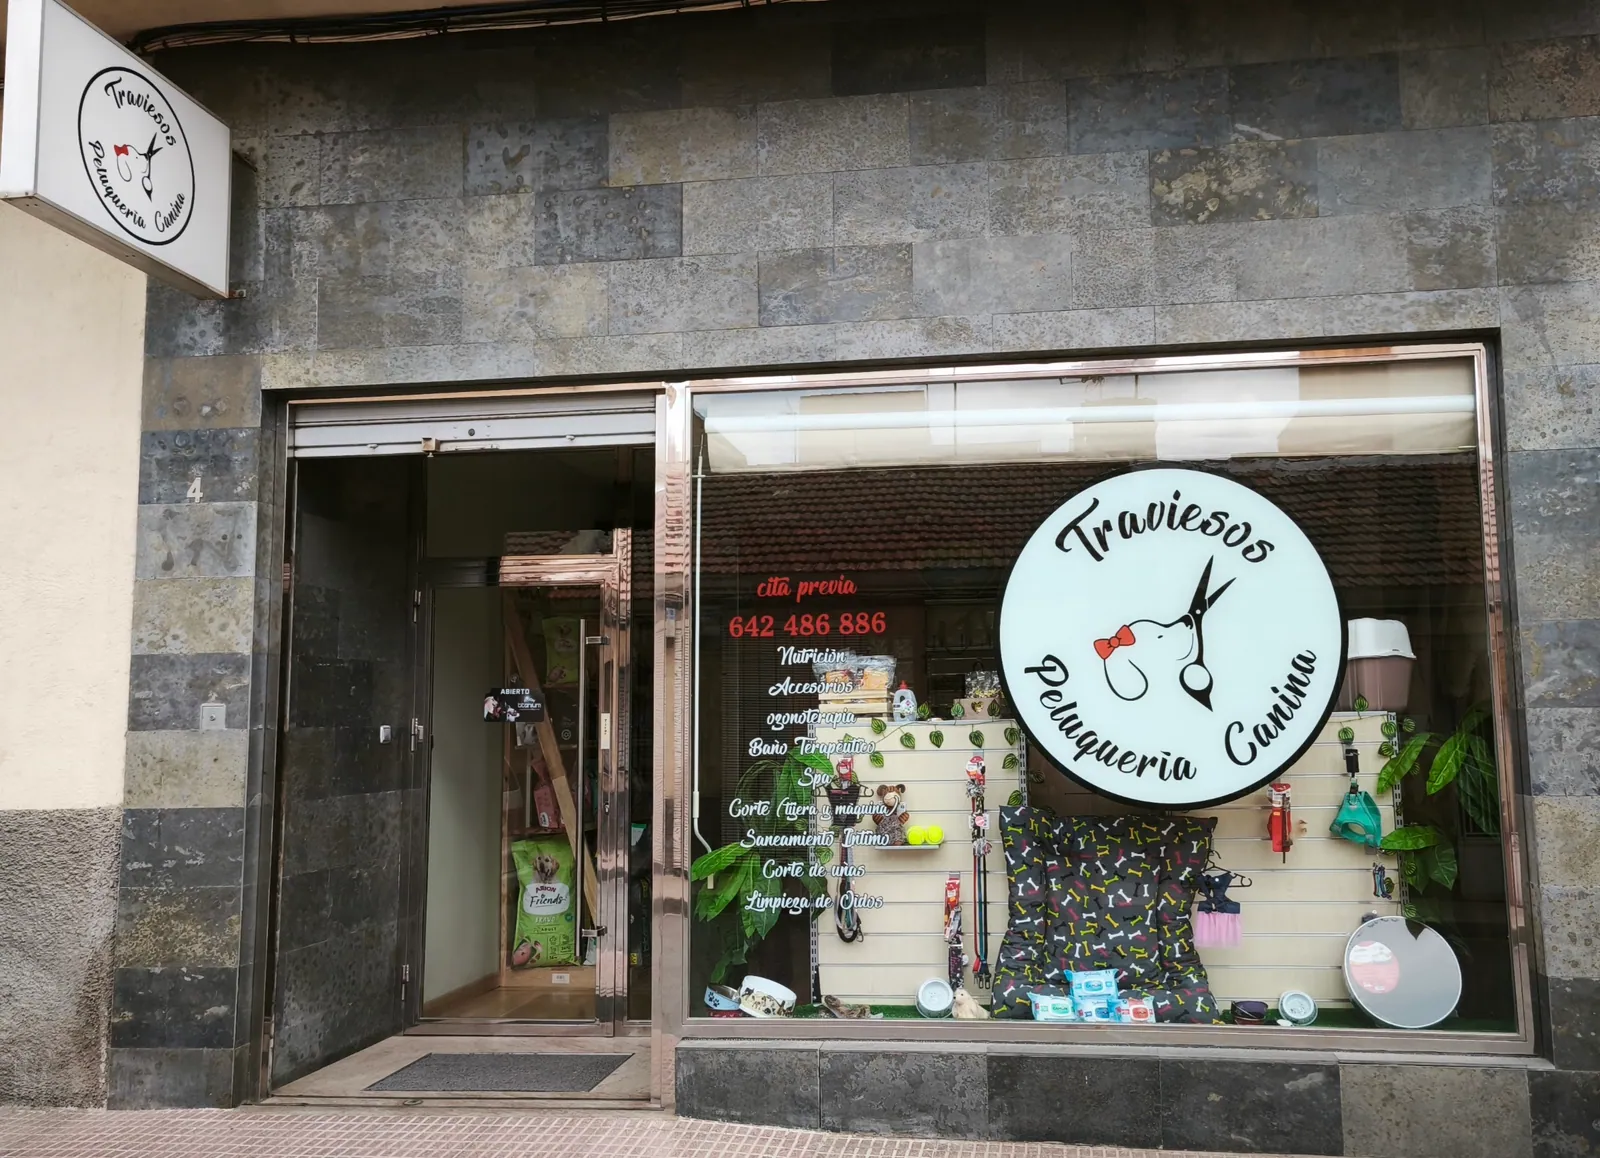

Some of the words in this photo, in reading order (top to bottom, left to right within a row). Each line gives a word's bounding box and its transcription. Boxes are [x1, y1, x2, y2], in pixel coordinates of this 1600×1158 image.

[104, 76, 176, 146] Traviesos
[154, 192, 186, 233] Canina
[186, 477, 203, 503] 4
[1054, 489, 1275, 563] Traviesos
[757, 576, 791, 597] cita
[796, 575, 857, 603] previa
[729, 615, 774, 638] 642
[783, 613, 830, 636] 486
[839, 612, 886, 635] 886
[768, 676, 853, 696] Accesorios
[766, 708, 857, 731] ozonoterapia
[1224, 649, 1317, 766] Canina
[797, 767, 832, 789] Spa
[728, 797, 771, 817] Corte
[740, 828, 835, 849] Saneamiento
[762, 859, 804, 879] Corte
[808, 863, 827, 878] de
[529, 894, 565, 908] Friends
[744, 890, 811, 915] Limpieza
[815, 894, 834, 909] de
